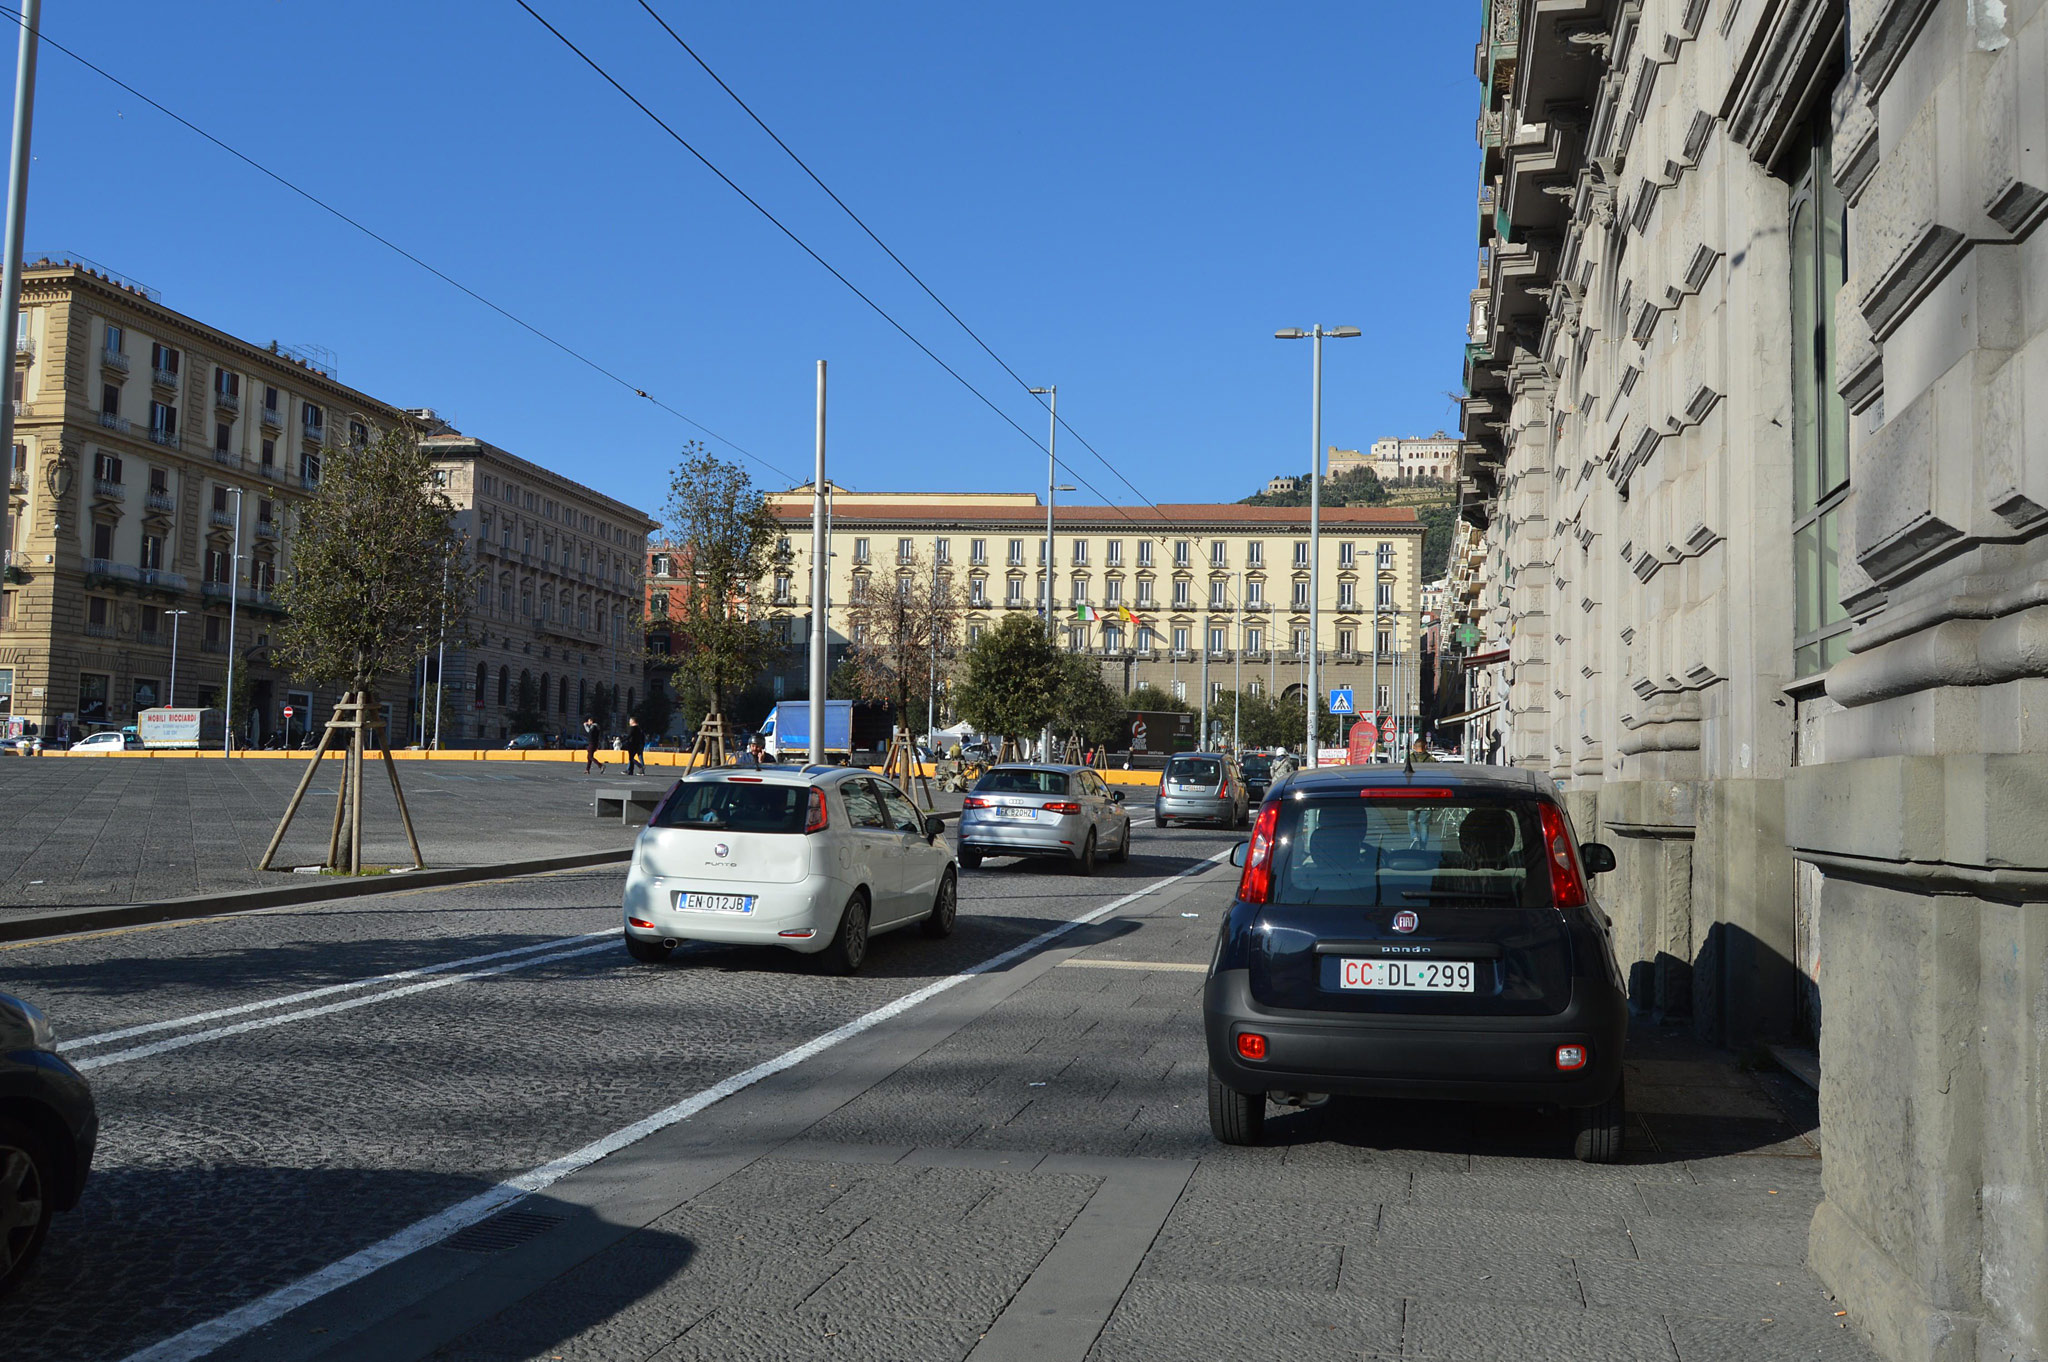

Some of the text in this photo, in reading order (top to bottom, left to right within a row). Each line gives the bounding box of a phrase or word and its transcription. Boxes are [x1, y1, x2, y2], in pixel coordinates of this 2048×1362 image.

[147, 714, 197, 722] MOBILI RICCIARDI
[688, 895, 744, 911] EN 012JB
[1399, 916, 1414, 928] FIAT
[1346, 962, 1470, 988] CC DL 299
